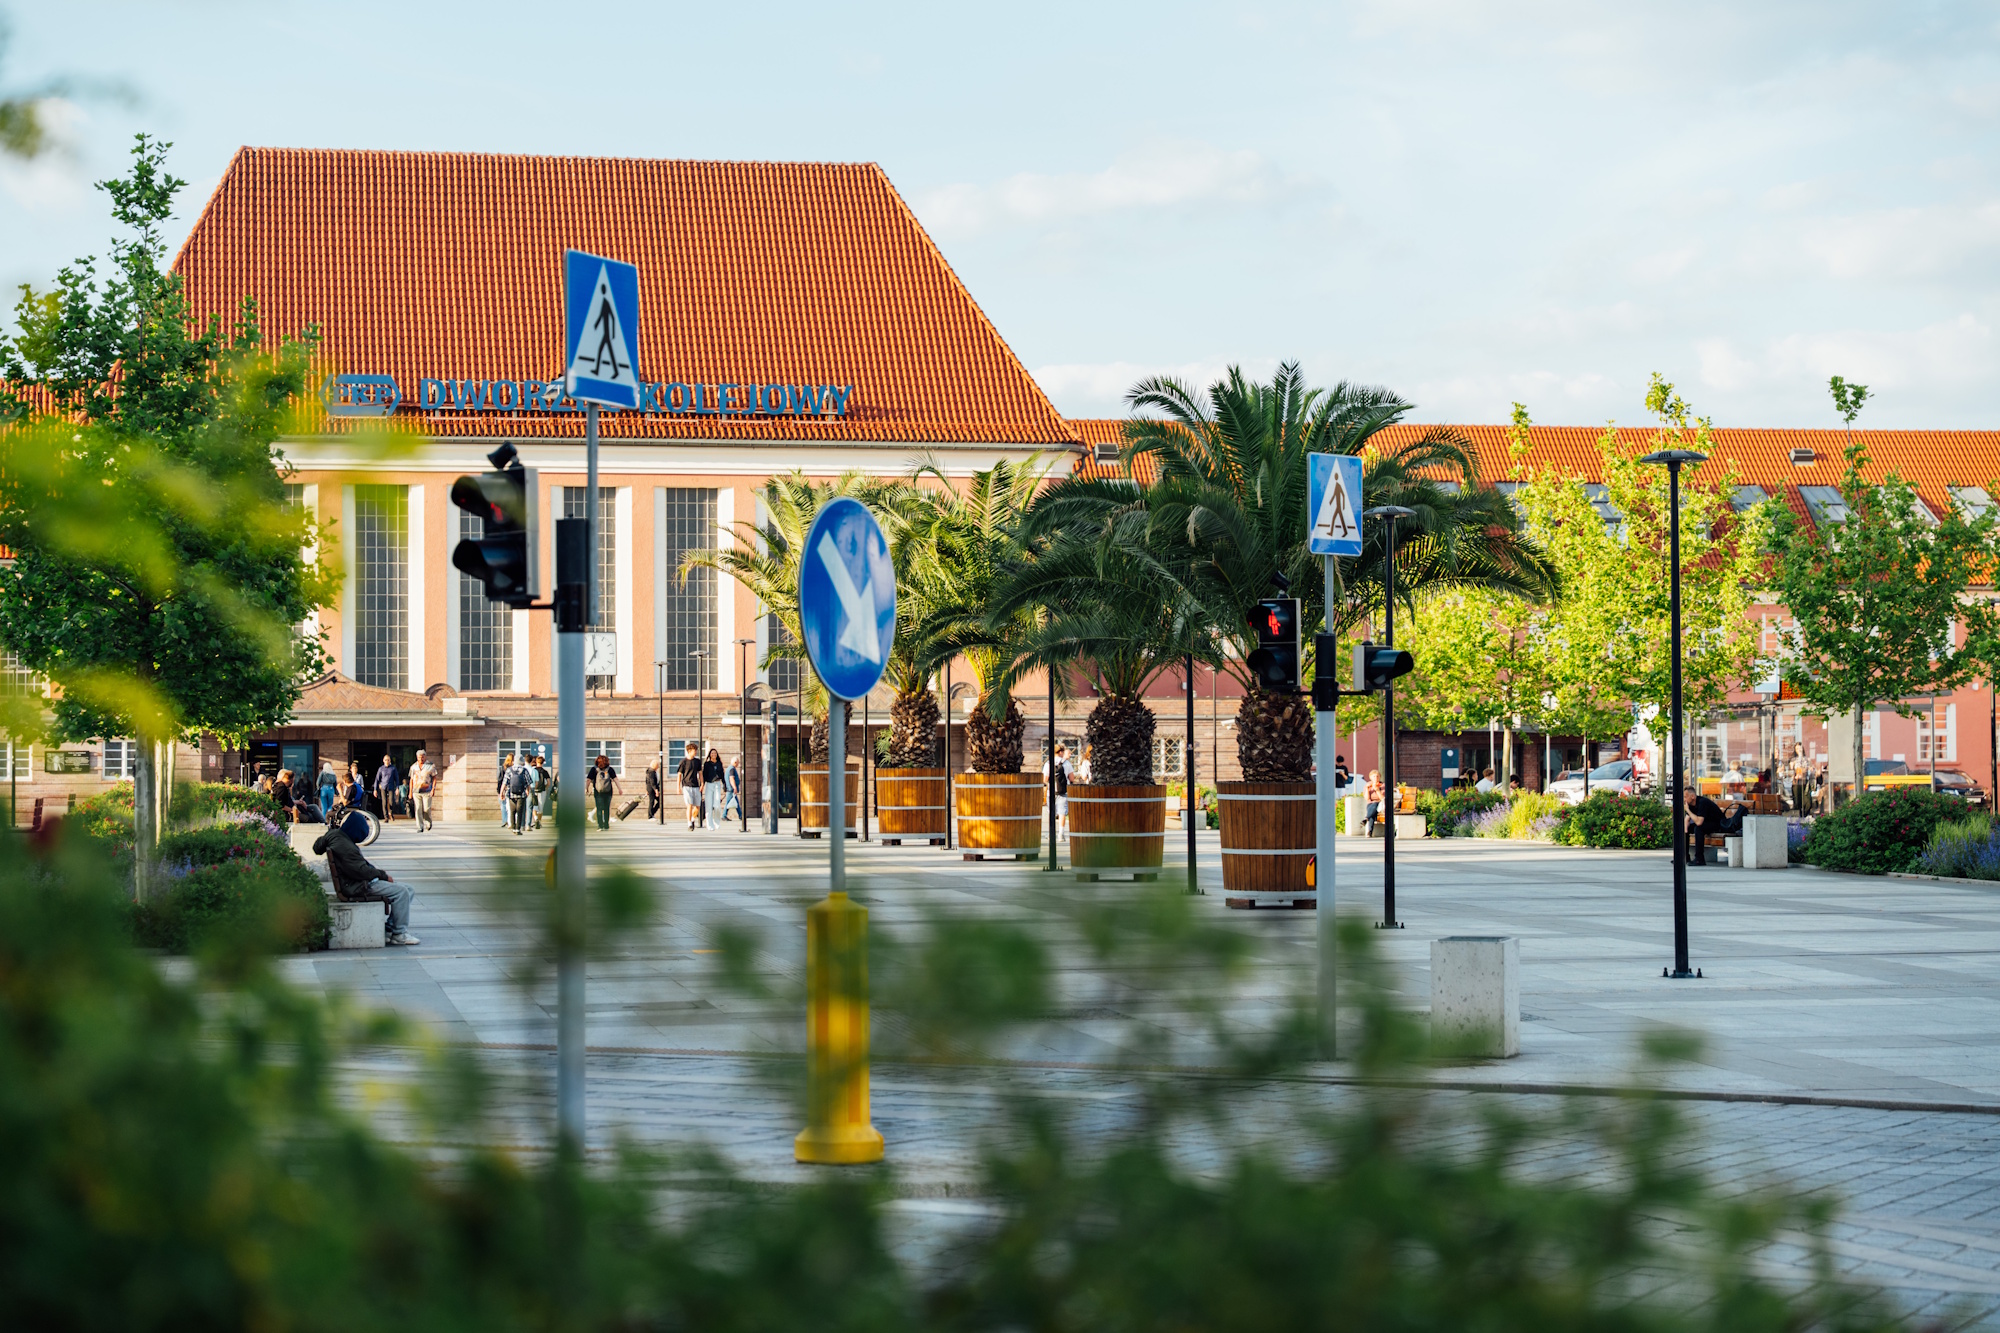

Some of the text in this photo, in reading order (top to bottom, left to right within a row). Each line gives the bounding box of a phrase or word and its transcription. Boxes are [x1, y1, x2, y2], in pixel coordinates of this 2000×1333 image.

[333, 386, 391, 404] PKP
[420, 378, 853, 415] DWORZ KOLEJOWY
